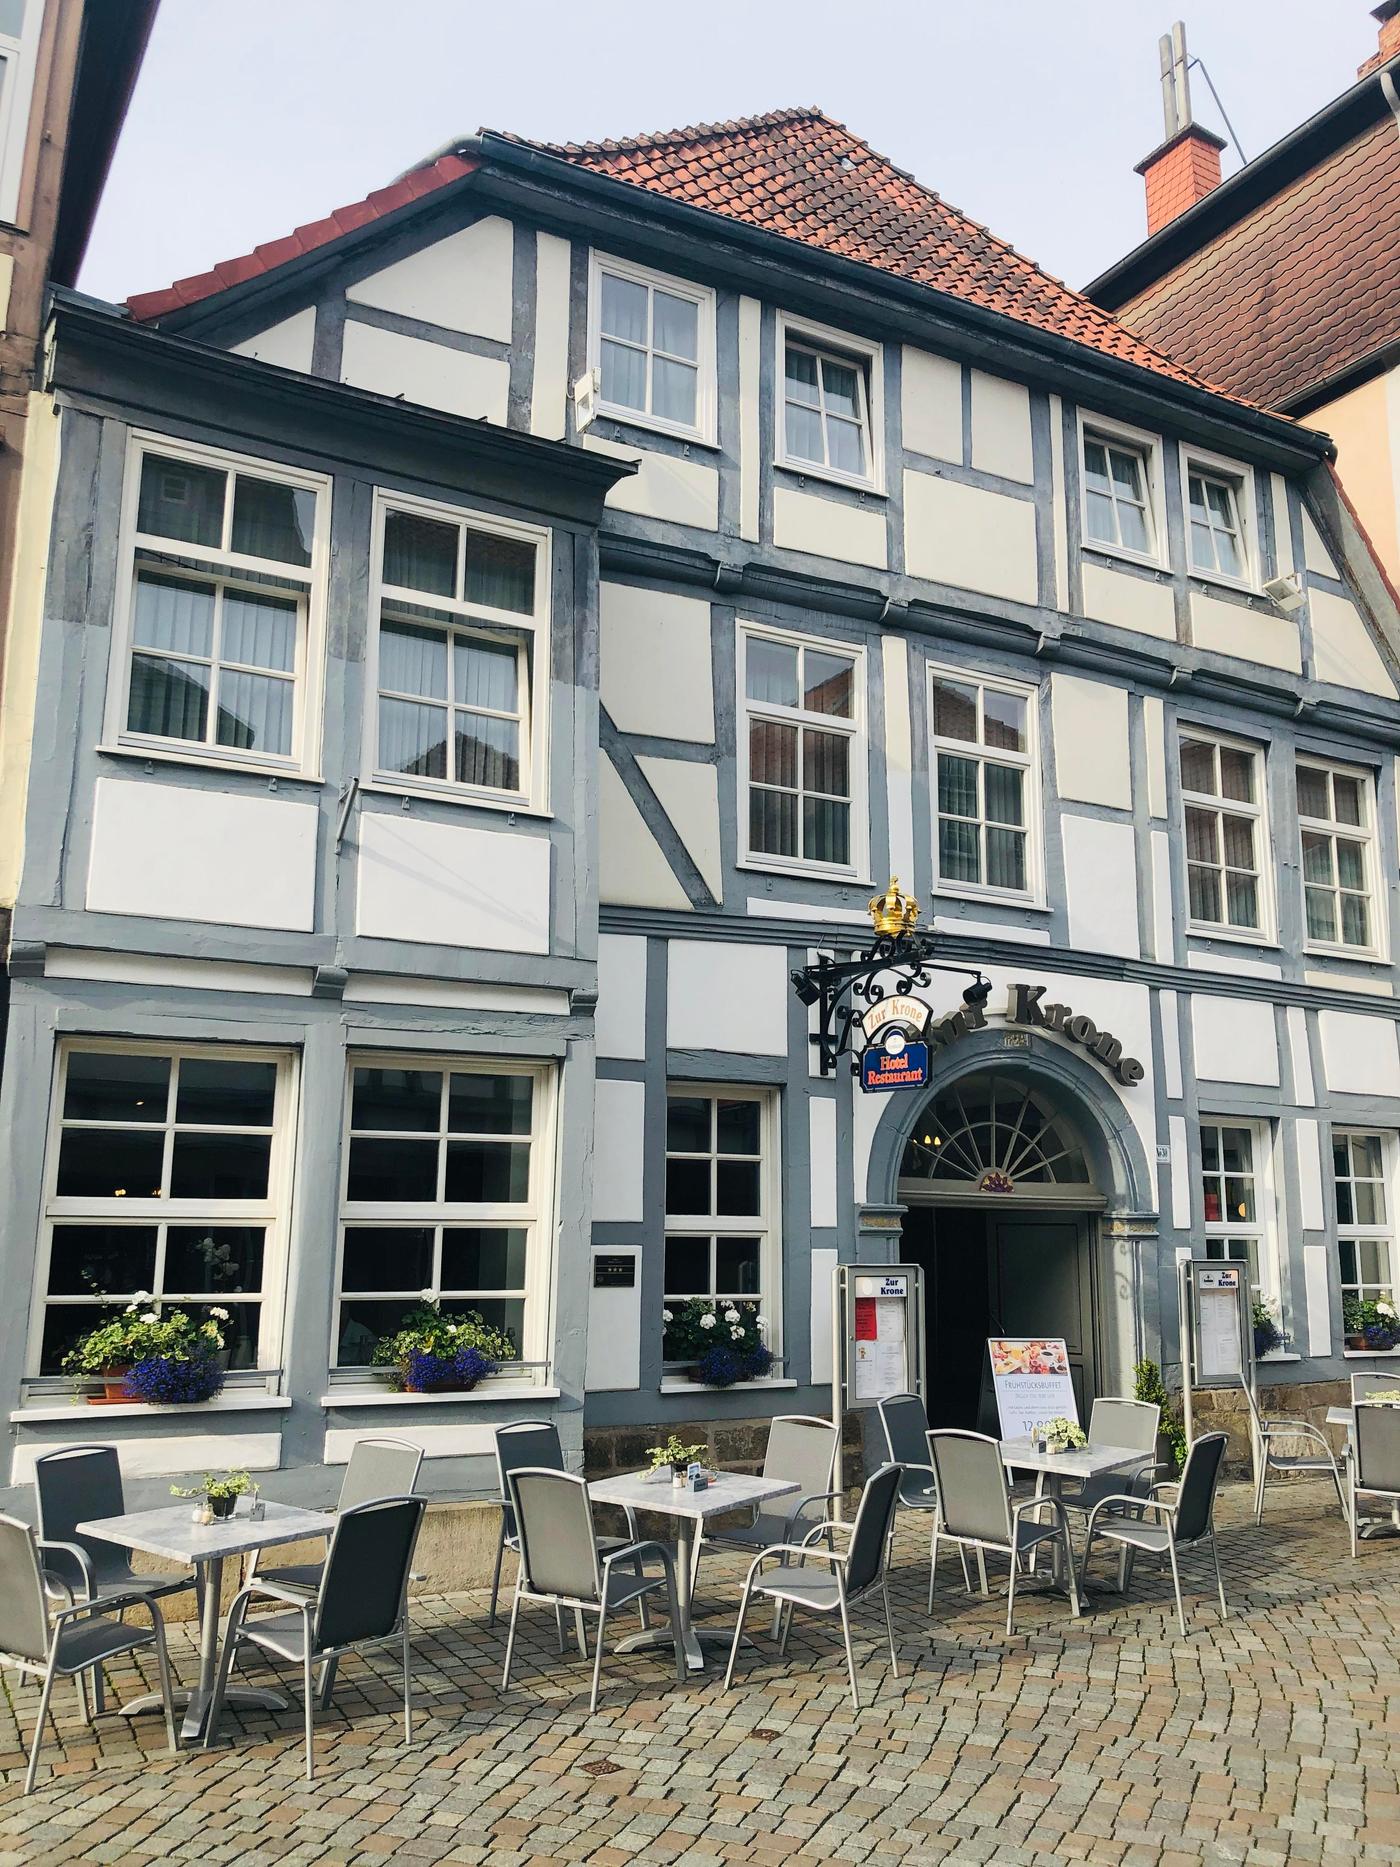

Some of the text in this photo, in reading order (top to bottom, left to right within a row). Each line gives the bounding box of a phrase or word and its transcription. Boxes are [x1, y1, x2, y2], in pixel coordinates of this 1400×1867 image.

[867, 999, 923, 1029] Zur Krone
[1006, 983, 1145, 1088] Krone
[880, 1053, 908, 1071] Hotel
[867, 1067, 922, 1085] Restaurant
[880, 1287, 904, 1295] Krone
[885, 1278, 899, 1287] Zur
[1218, 1279, 1236, 1287] Krone
